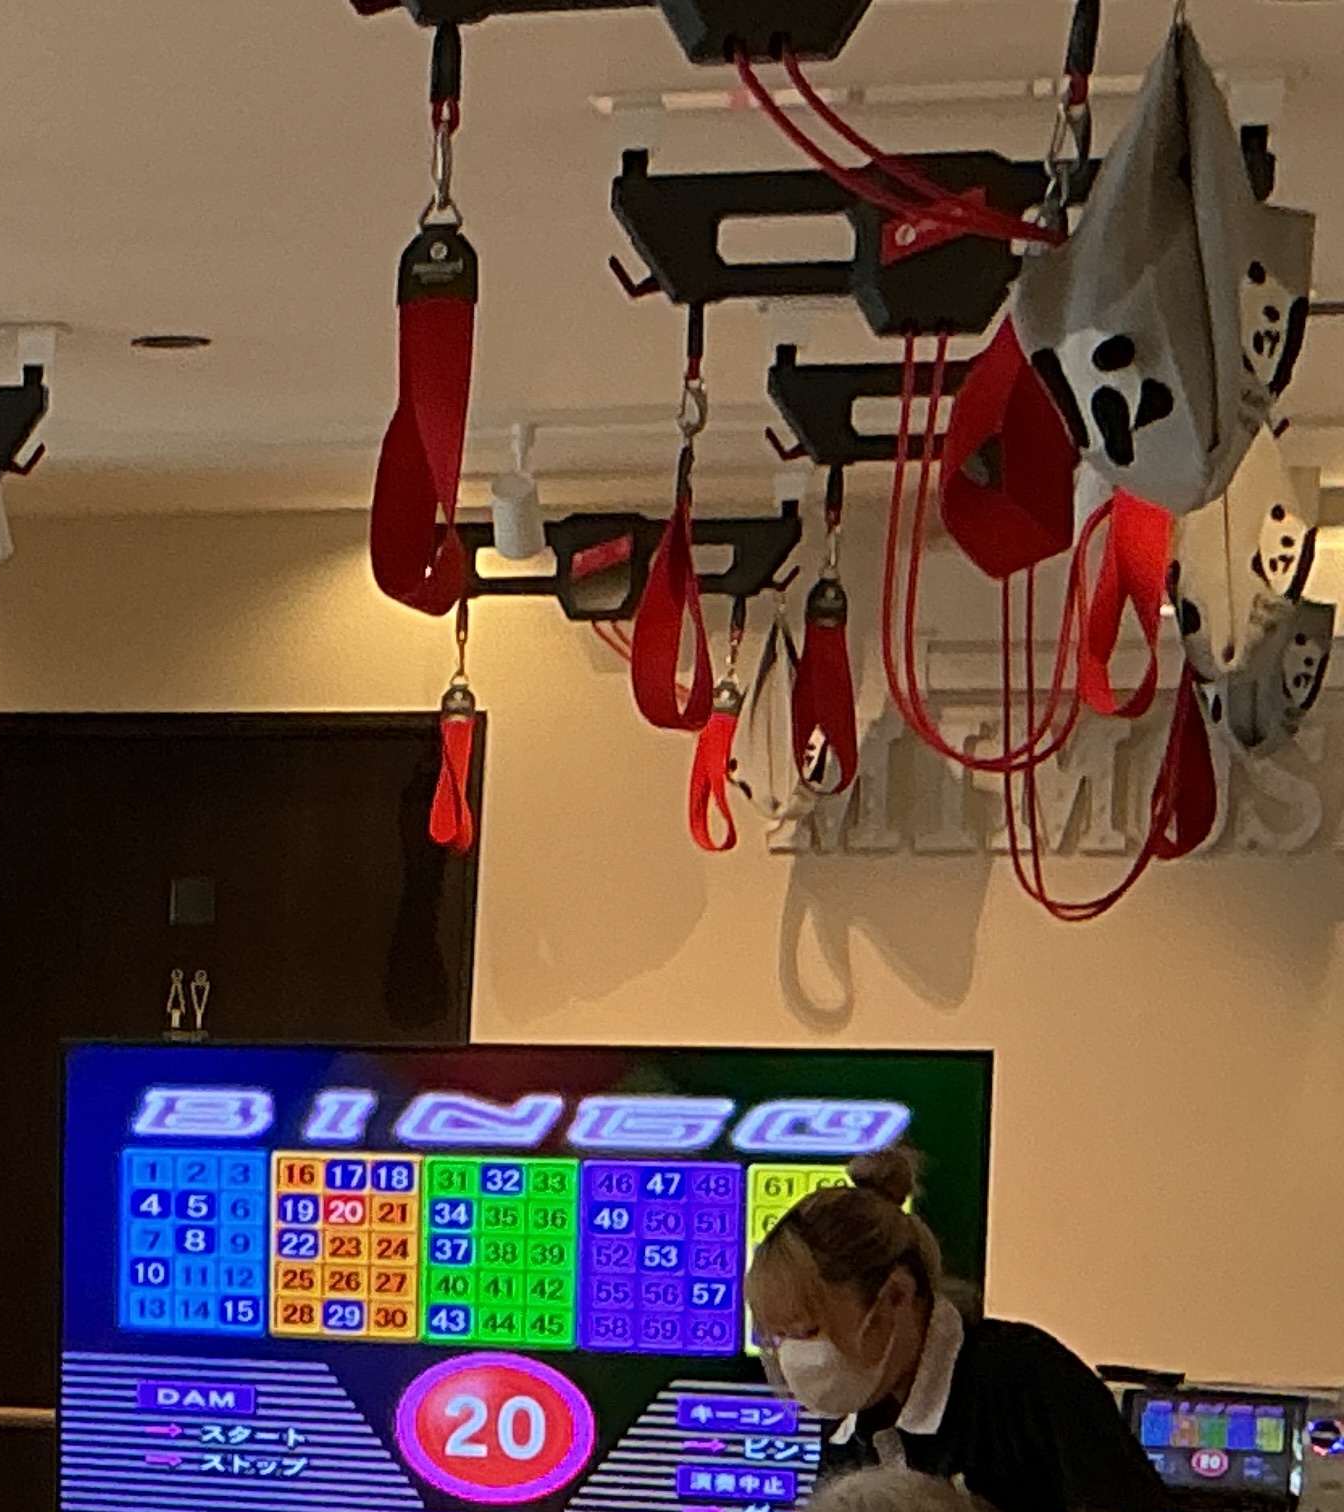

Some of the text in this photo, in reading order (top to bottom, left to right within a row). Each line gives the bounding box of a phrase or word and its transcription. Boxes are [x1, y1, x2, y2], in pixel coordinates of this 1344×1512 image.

[133, 1086, 911, 1154] BINGO
[145, 1161, 157, 1182] 1
[186, 1162, 206, 1182] 2
[229, 1162, 251, 1183] 3
[283, 1163, 315, 1185] 16
[330, 1165, 364, 1189] 17
[377, 1166, 409, 1189] 18
[436, 1169, 468, 1192] 31
[485, 1167, 521, 1192] 32
[532, 1171, 567, 1193] 33
[597, 1172, 634, 1195] 46
[645, 1171, 681, 1195] 47
[695, 1175, 732, 1198] 48
[764, 1176, 794, 1197] 61
[139, 1194, 162, 1217] 4
[186, 1194, 209, 1218] 5
[230, 1200, 251, 1220] 6
[282, 1200, 314, 1222] 19
[327, 1199, 364, 1223] 20
[377, 1202, 409, 1224] 21
[433, 1202, 469, 1225] 34
[484, 1207, 519, 1228] 35
[532, 1207, 567, 1229] 36
[593, 1207, 630, 1230] 49
[644, 1210, 682, 1233] 50
[695, 1211, 729, 1234] 51
[145, 1228, 729, 1271] 7 8 9 22 23 24 37 38 39 52 53 54
[133, 1262, 727, 1305] 10 11 12 25 26 27 40 41 42 55 56 57
[137, 1299, 727, 1342] 13 14 15 28 29 30 43 44 45 58 59 60
[155, 1386, 237, 1410] DAM
[689, 1403, 786, 1427] キーコン
[199, 1423, 309, 1450] スタート
[444, 1394, 547, 1461] 20
[199, 1452, 310, 1478] ストップ
